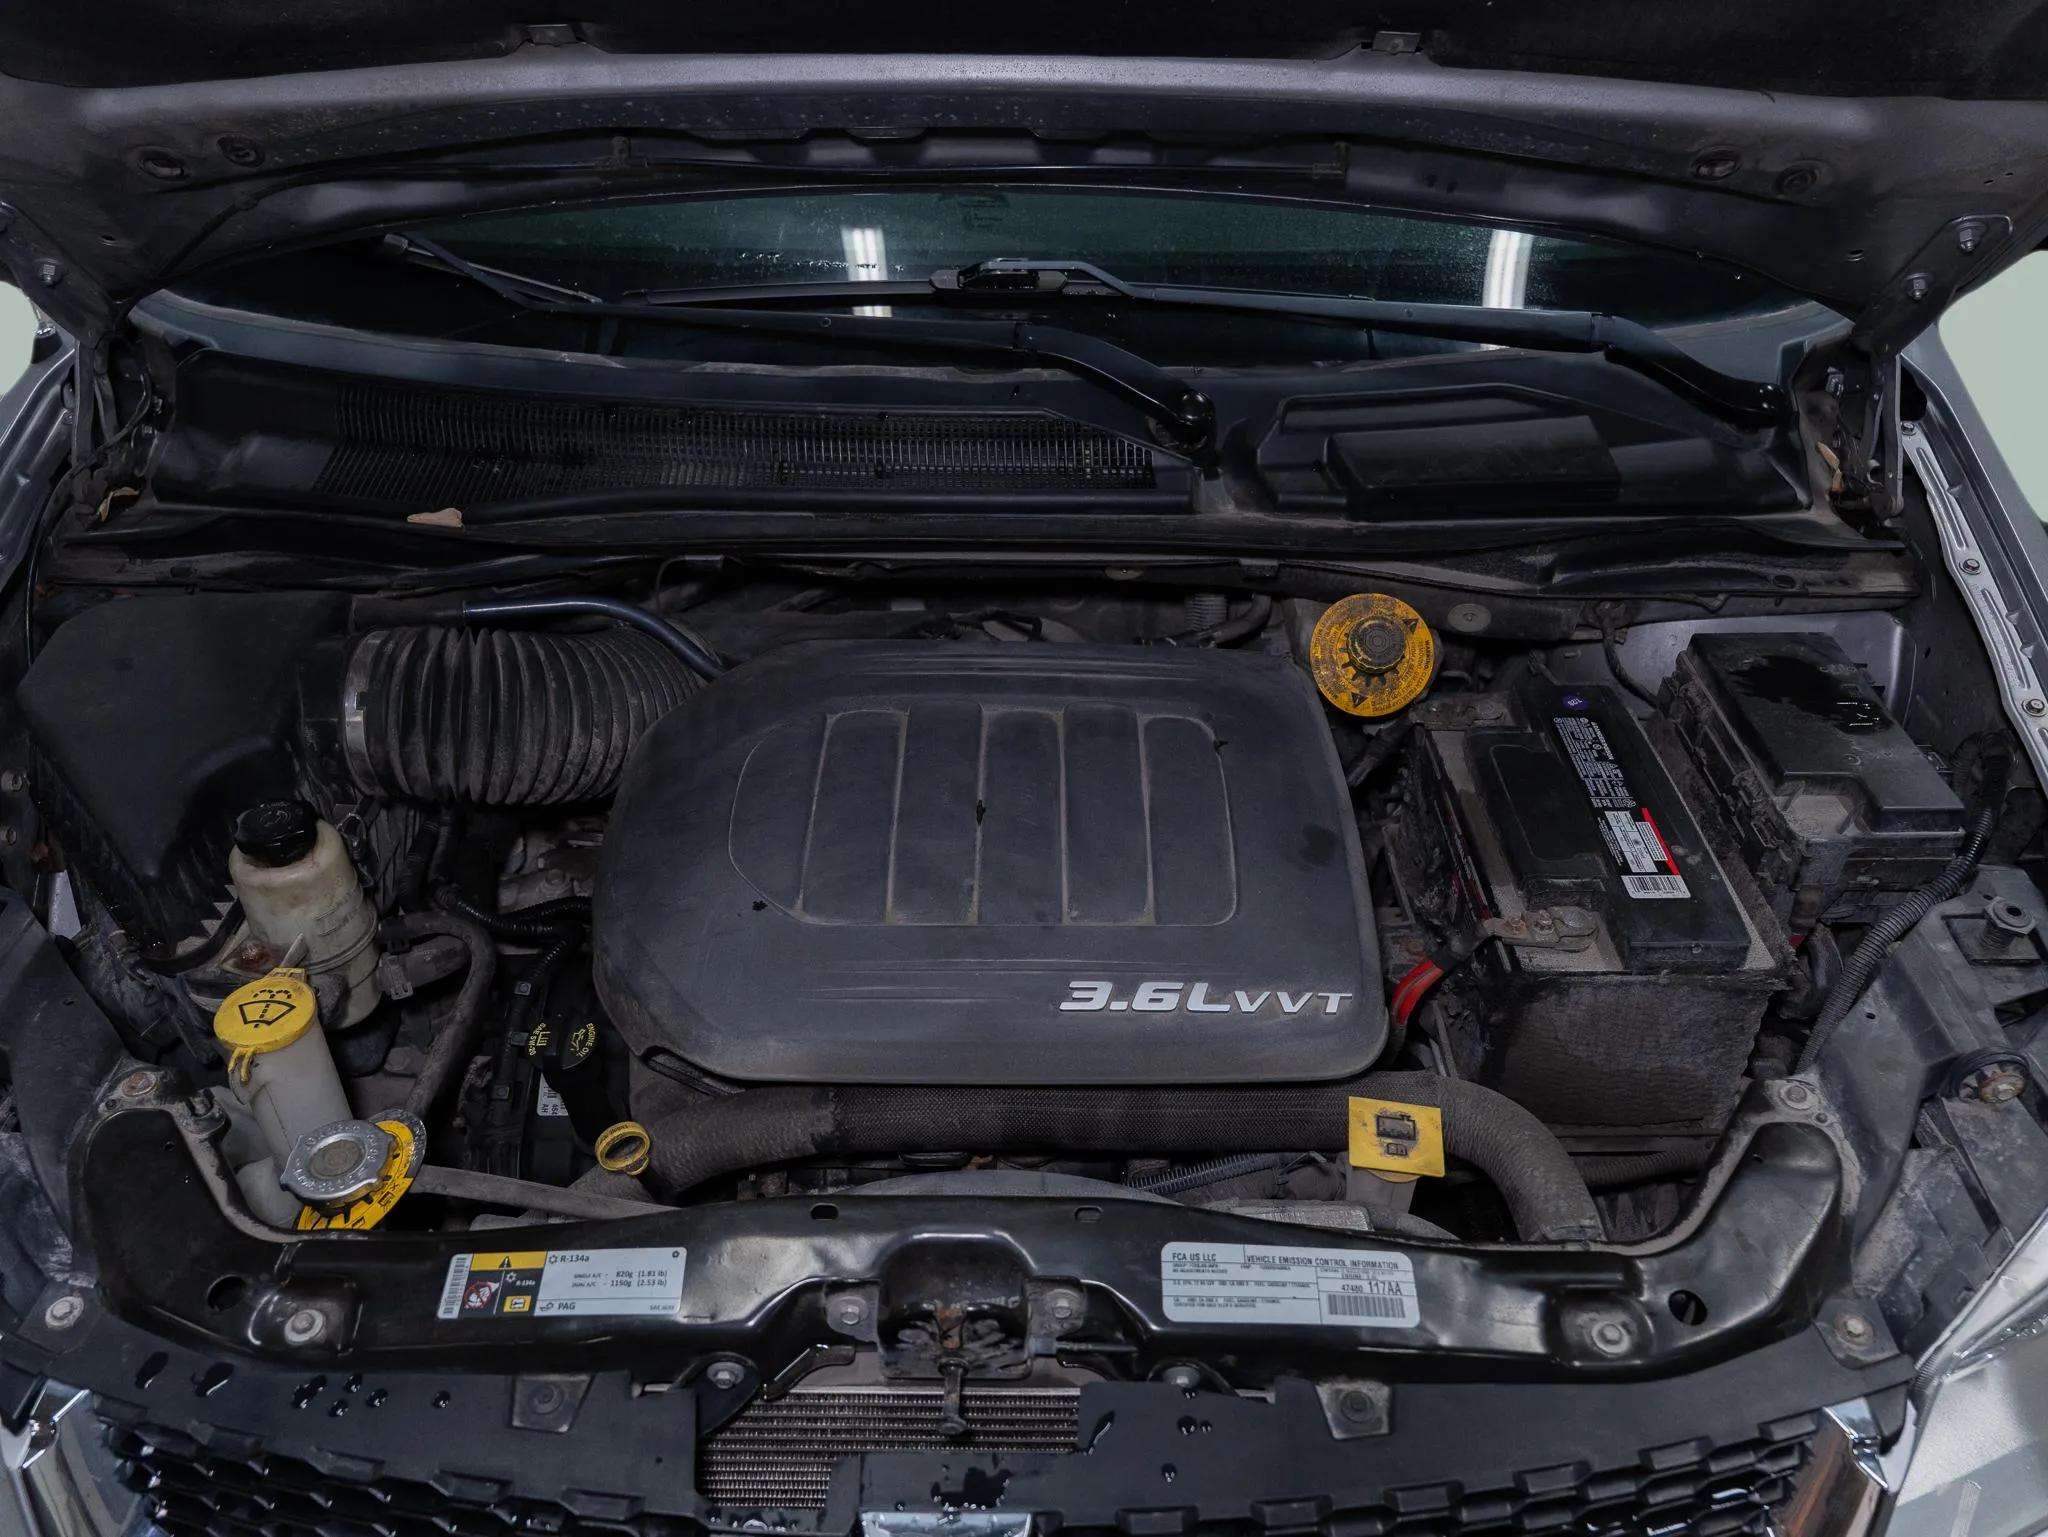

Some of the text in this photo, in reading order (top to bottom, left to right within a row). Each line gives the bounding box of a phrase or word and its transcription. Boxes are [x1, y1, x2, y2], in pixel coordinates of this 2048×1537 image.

[1059, 981, 1353, 1014] 3.6L VVT
[576, 1022, 596, 1058] ENGINE OIL
[560, 1254, 590, 1263] R-134a
[1172, 1252, 1217, 1262] FCA US LLC
[1246, 1255, 1276, 1264] VEHICLE
[1278, 1256, 1313, 1266] EMISSION
[1315, 1257, 1346, 1266] CONTROL
[1349, 1259, 1400, 1270] INFORMATION
[616, 1270, 634, 1279] 820g
[610, 1279, 633, 1288] 1150g
[1368, 1280, 1403, 1296] 117AA
[558, 1302, 576, 1311] PAG
